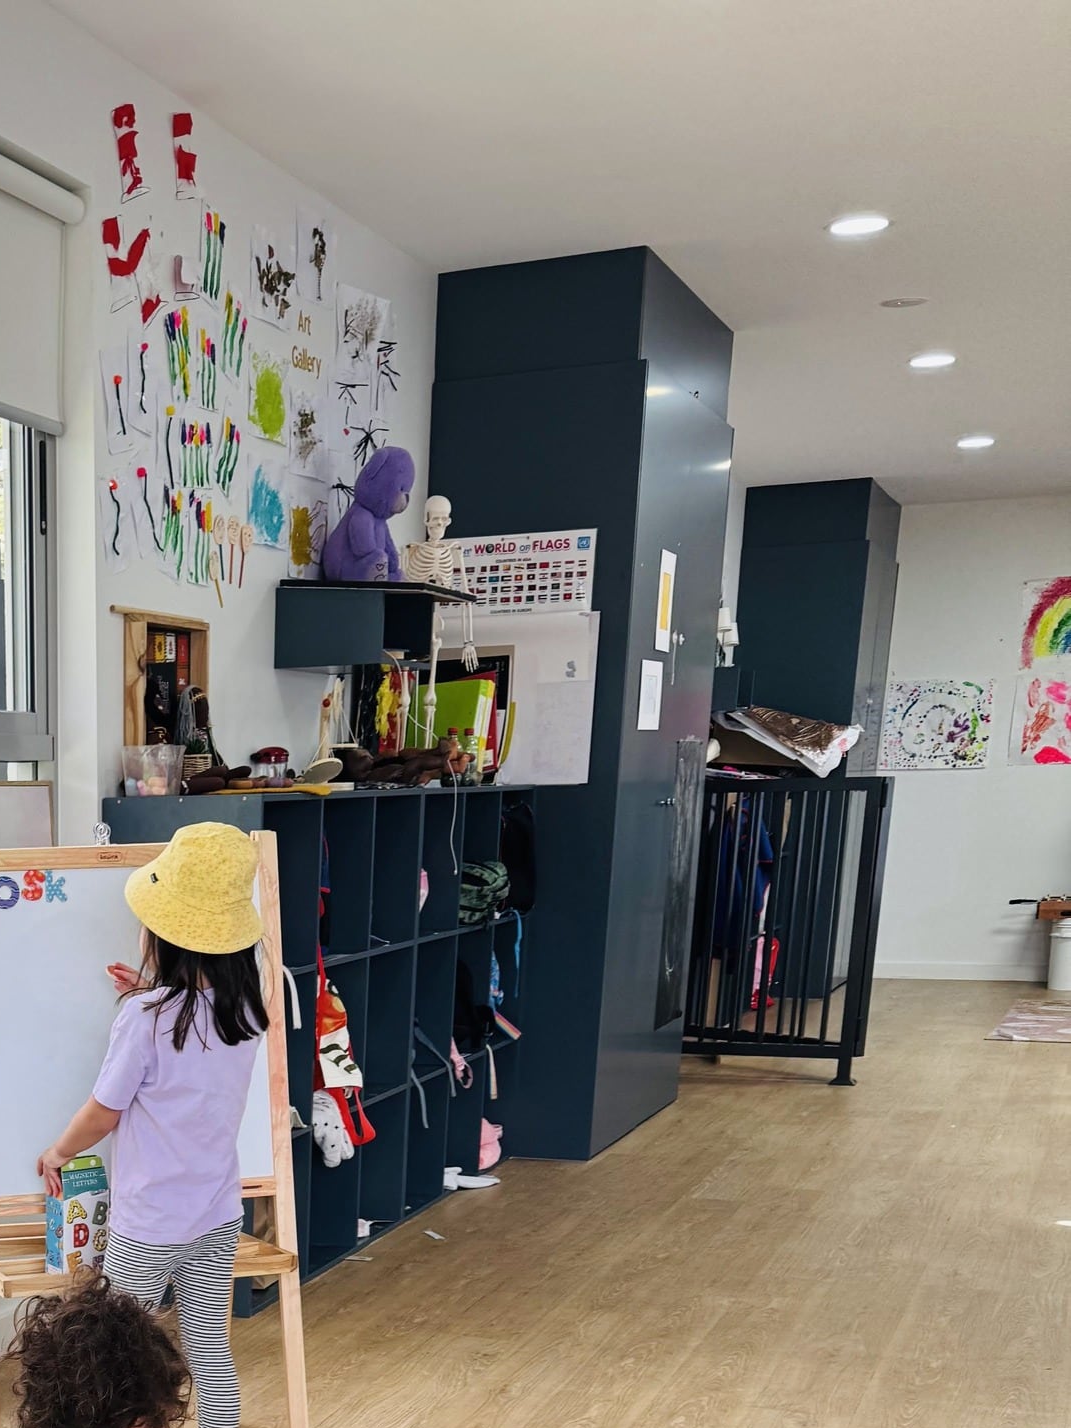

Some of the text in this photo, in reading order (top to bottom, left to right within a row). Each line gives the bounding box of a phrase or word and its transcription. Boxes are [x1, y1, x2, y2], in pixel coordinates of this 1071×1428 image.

[297, 310, 311, 336] Art
[292, 345, 322, 380] Gallery
[474, 542, 516, 555] WORLD
[532, 538, 570, 550] FLAGS
[69, 1171, 98, 1180] MAGNETIC
[67, 1199, 87, 1224] A
[74, 1223, 89, 1248] D
